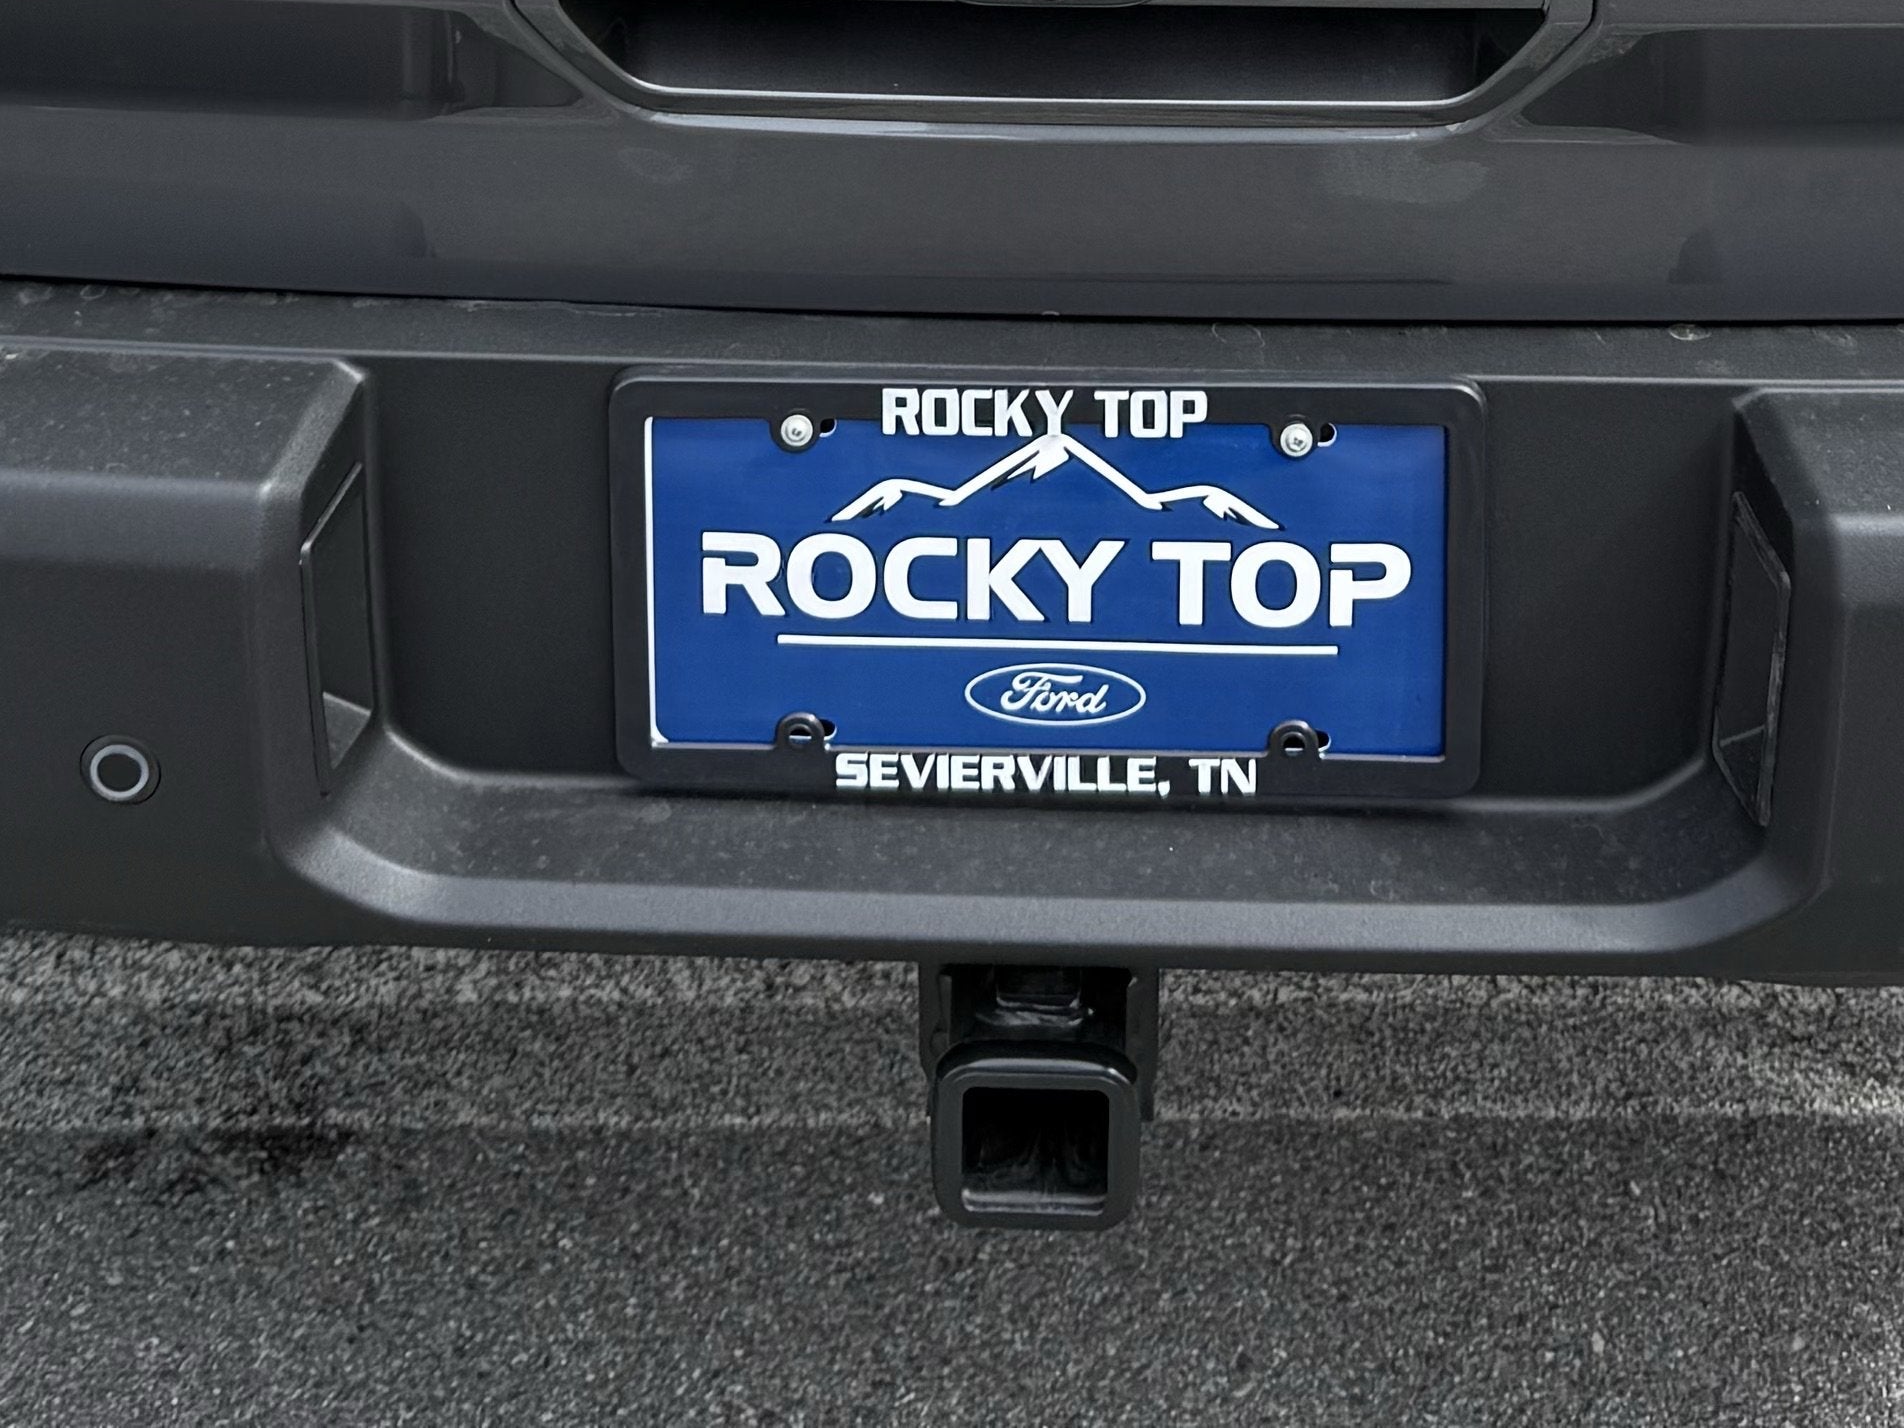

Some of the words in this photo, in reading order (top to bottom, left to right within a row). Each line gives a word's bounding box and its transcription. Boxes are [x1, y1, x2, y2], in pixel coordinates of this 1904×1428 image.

[882, 387, 1074, 438] ROCKY
[1094, 390, 1208, 439] TOP
[702, 531, 1125, 623] ROCKY
[1151, 541, 1412, 629] TOP
[1001, 671, 1108, 714] Ford
[835, 751, 1171, 797] SEVIERVILLE,
[1188, 758, 1257, 795] TN
